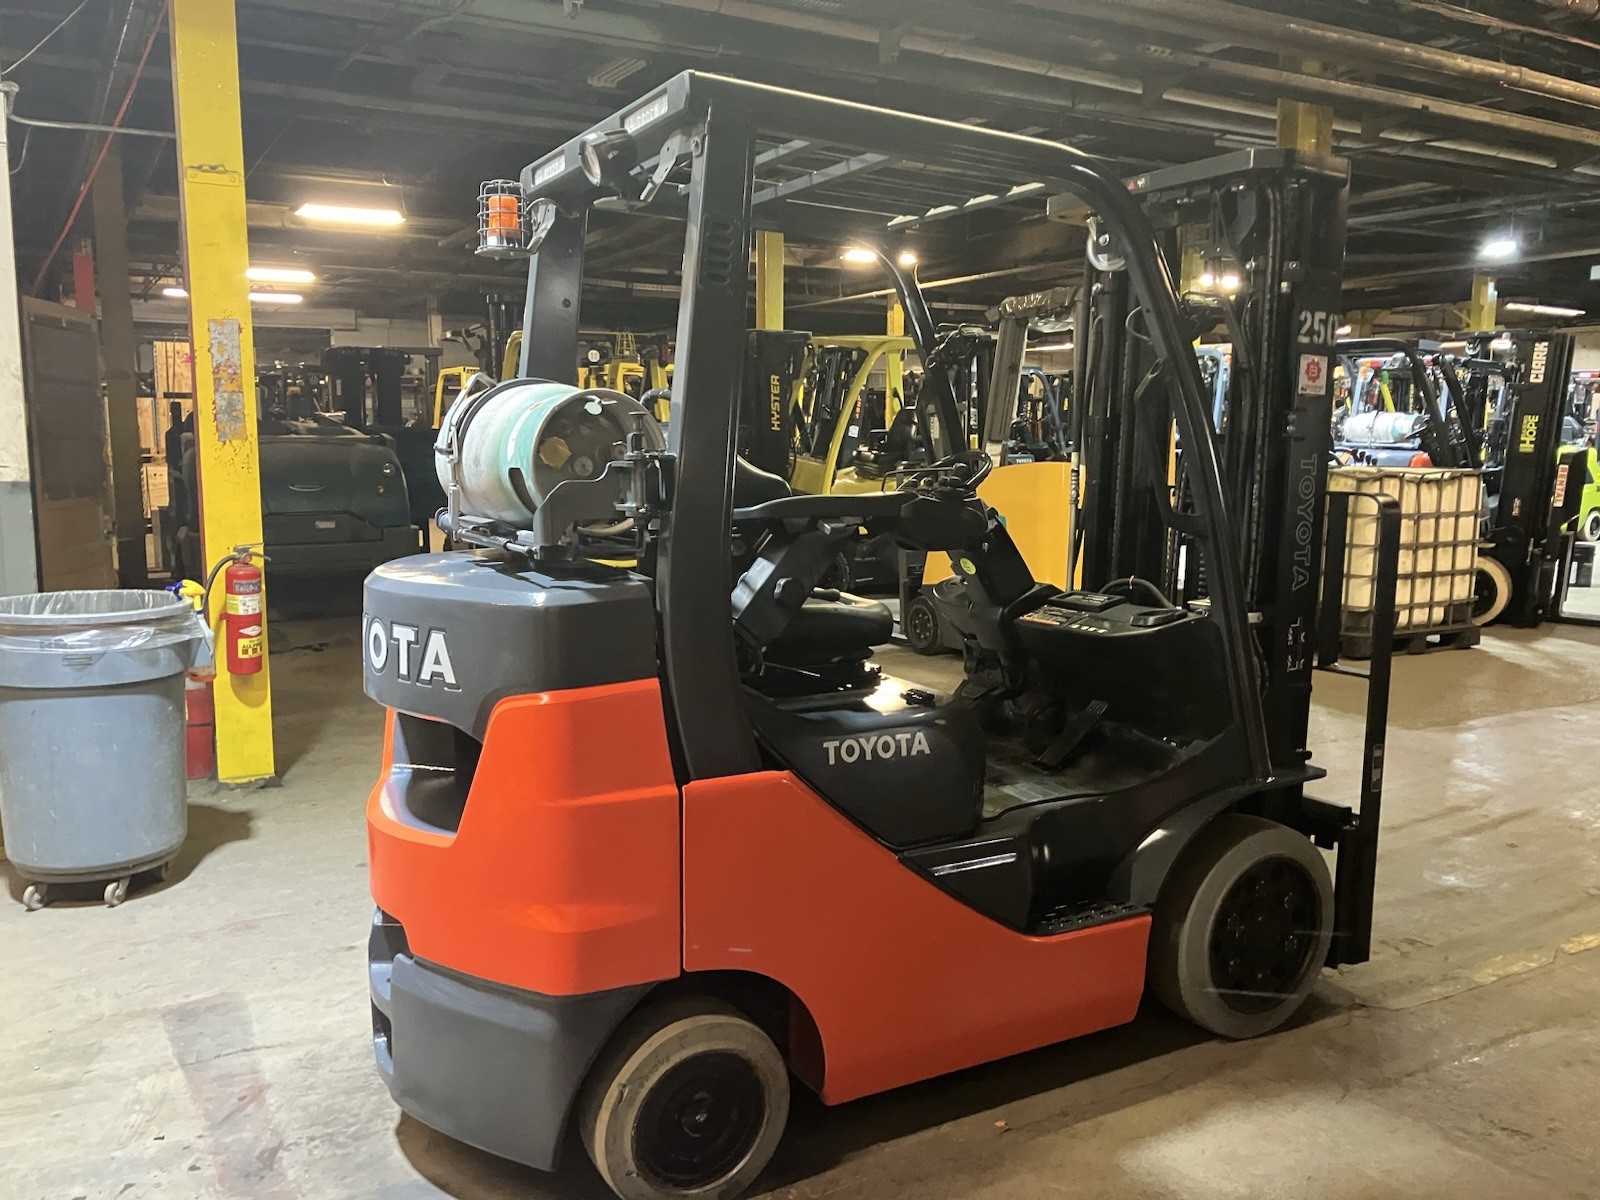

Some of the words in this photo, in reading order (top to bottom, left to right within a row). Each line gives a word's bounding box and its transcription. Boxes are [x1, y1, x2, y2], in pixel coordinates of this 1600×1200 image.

[1297, 310, 1339, 346] 250
[1529, 341, 1549, 383] CLARK
[770, 374, 781, 431] HYSTER
[1555, 467, 1567, 504] RENTAL
[1291, 453, 1318, 592] TOYOTA
[363, 617, 458, 686] OTA
[822, 731, 931, 765] TOYOTA
